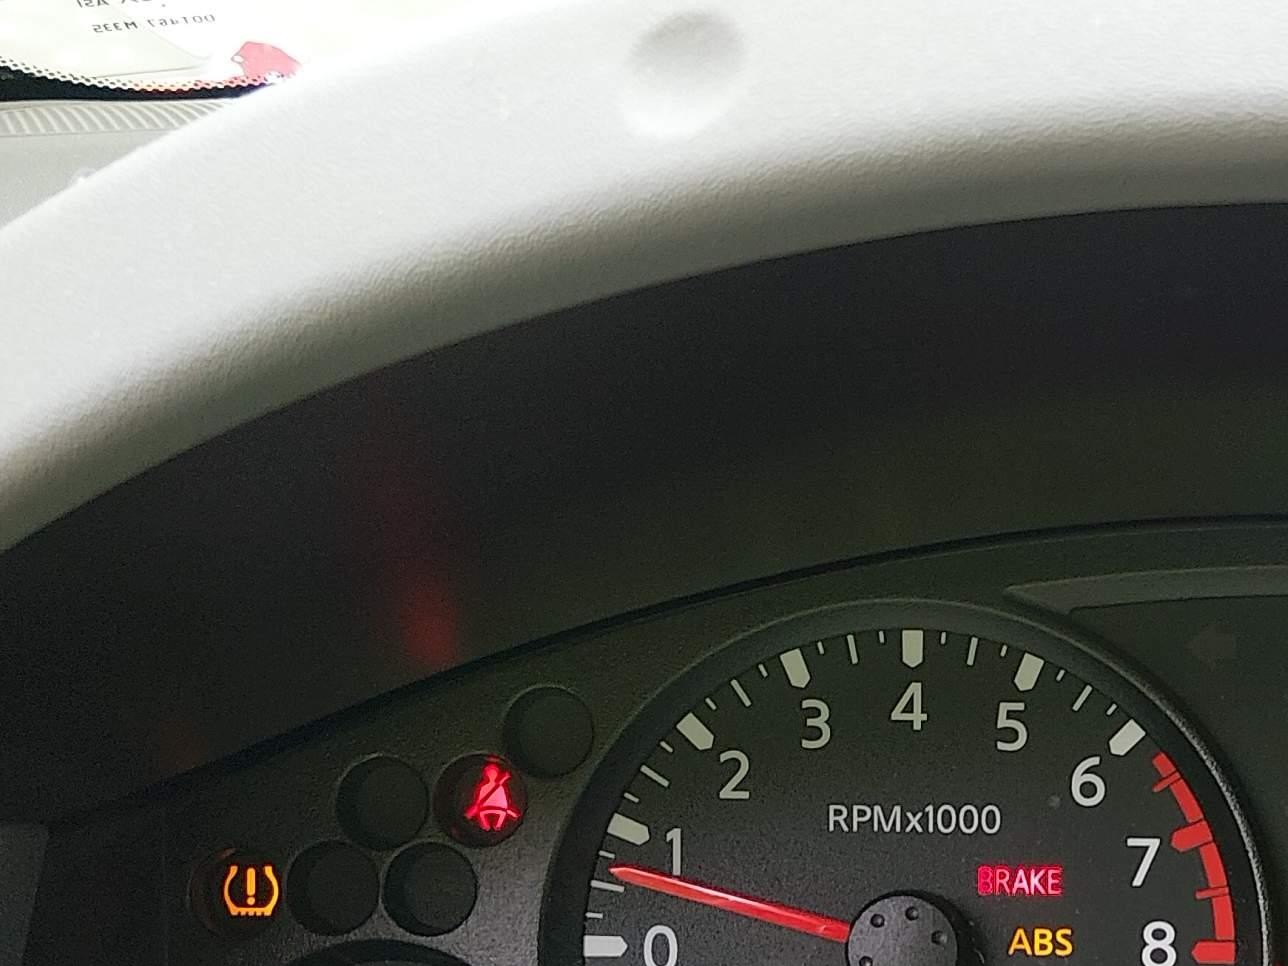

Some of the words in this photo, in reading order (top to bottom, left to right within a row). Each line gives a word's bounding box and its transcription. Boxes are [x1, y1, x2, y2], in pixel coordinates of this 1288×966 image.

[802, 700, 831, 749] 3
[892, 683, 927, 730] 4
[997, 703, 1027, 752] 5
[720, 751, 750, 799] 2
[1071, 757, 1105, 807] 6
[828, 805, 1001, 833] RPMx1000
[666, 828, 682, 876] 1
[1127, 838, 1160, 887] 7
[978, 866, 1063, 896] BRAKE
[1008, 928, 1073, 957] ABS
